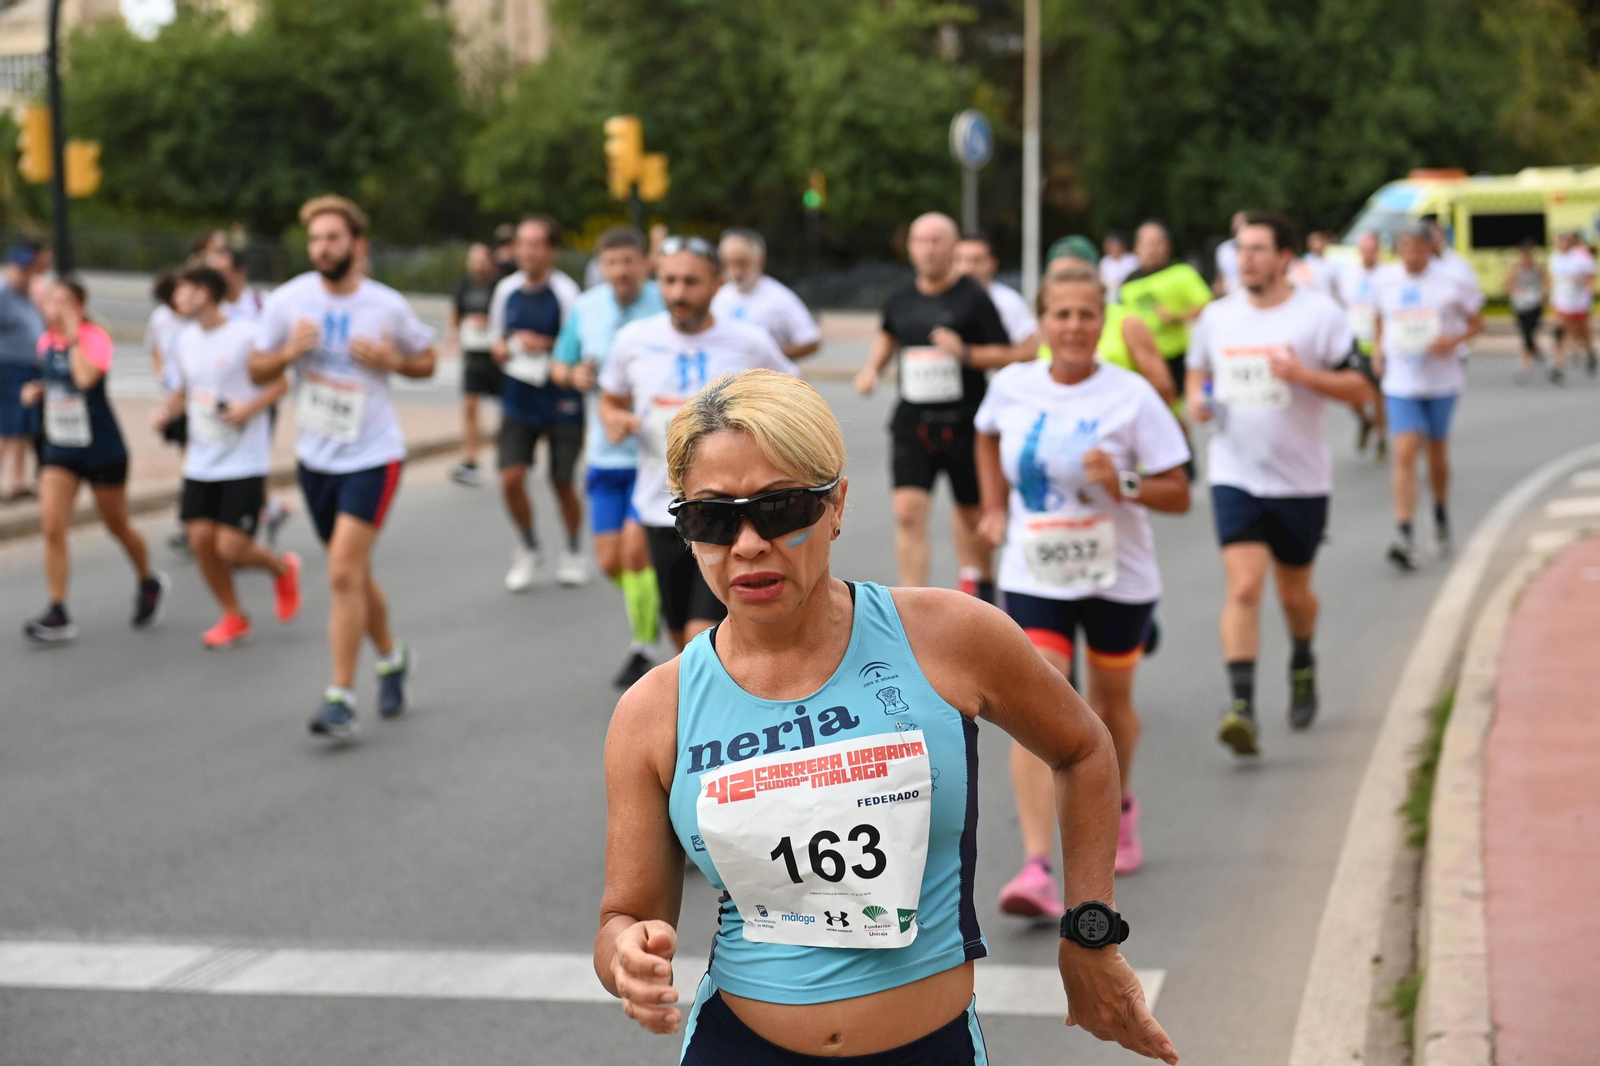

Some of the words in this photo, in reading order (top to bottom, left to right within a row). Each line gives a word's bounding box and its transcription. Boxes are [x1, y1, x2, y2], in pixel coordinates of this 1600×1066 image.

[687, 705, 860, 774] nerja
[755, 753, 843, 782] CARRERA
[847, 742, 925, 766] URBANA
[756, 777, 801, 792] CIUDAD
[811, 762, 888, 789] MÁLAGA
[705, 769, 756, 805] 42
[857, 790, 919, 807] FEDERADO
[770, 824, 887, 884] 163
[1088, 911, 1097, 938] 21:44
